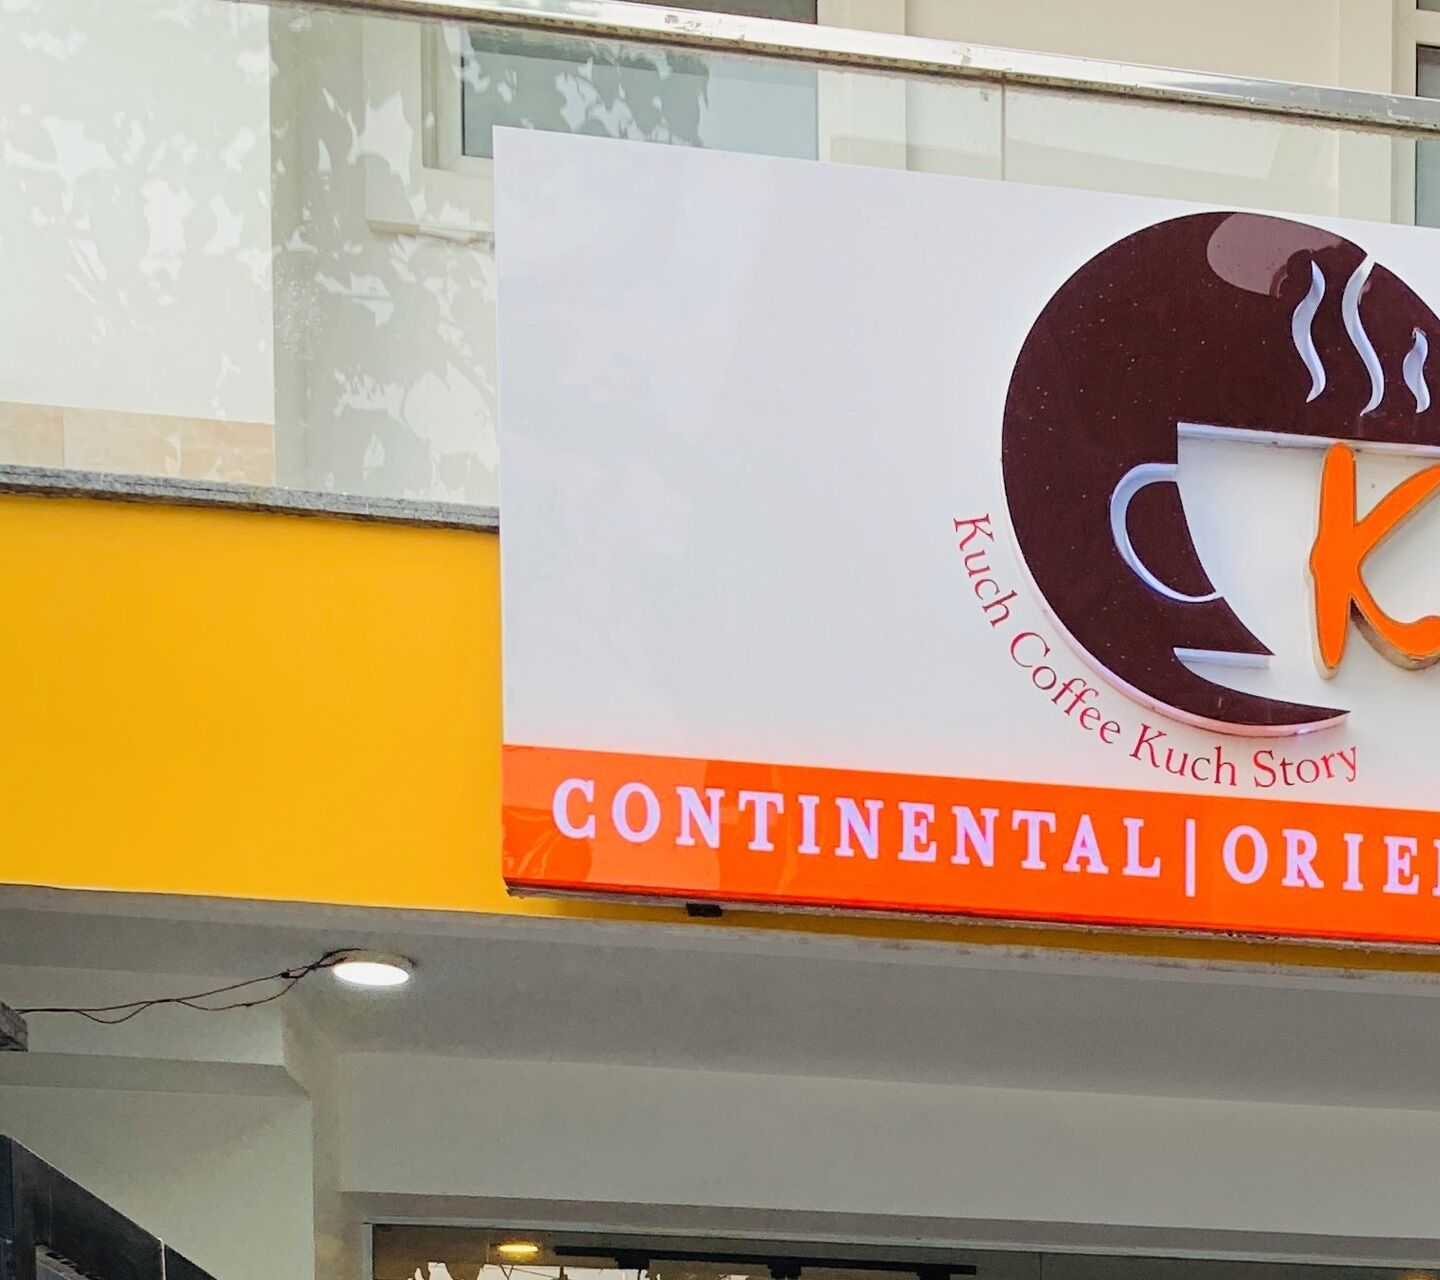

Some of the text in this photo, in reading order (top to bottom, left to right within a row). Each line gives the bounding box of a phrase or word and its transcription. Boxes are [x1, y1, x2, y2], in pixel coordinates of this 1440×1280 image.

[953, 513, 1358, 788] Kuch Coffee Kuch Story
[552, 778, 1161, 878] CONTINENTAL
